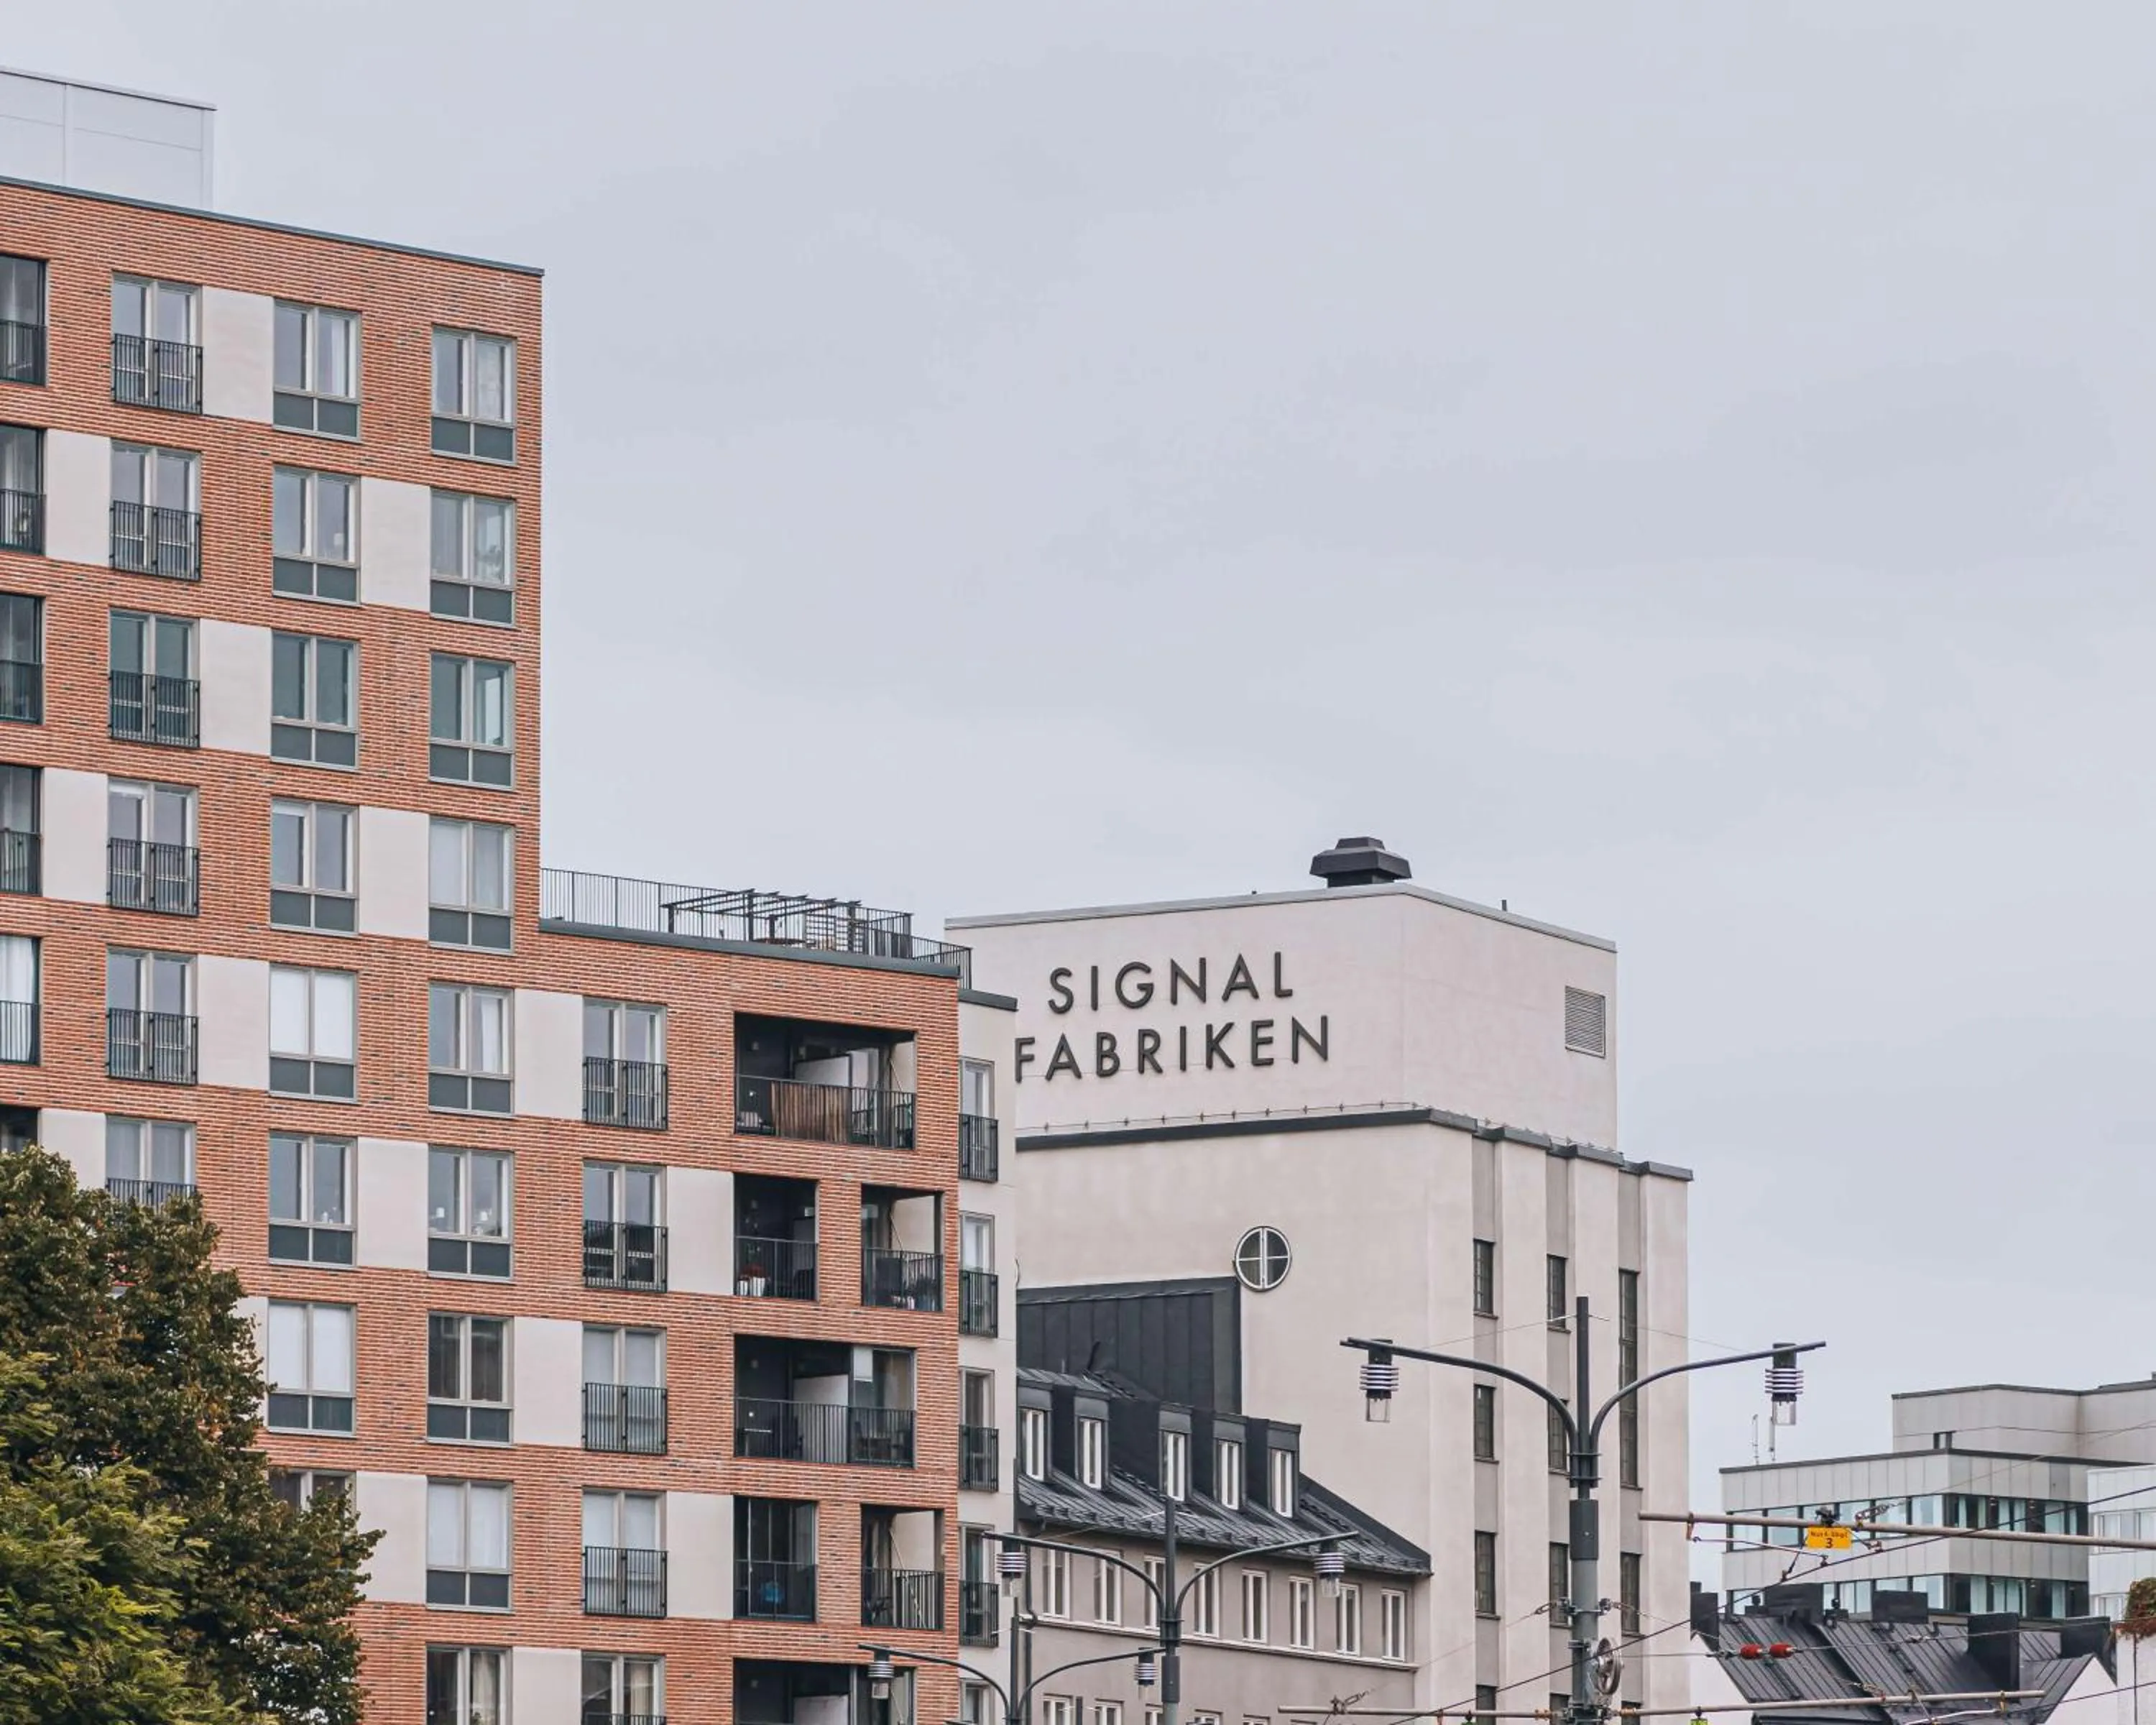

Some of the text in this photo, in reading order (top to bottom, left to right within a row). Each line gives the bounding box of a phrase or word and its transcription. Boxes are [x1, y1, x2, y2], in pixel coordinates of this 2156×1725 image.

[1048, 951, 1294, 1015] SIGNAL
[1014, 1015, 1329, 1084] FABRIKEN
[1825, 1537, 1833, 1548] 3
